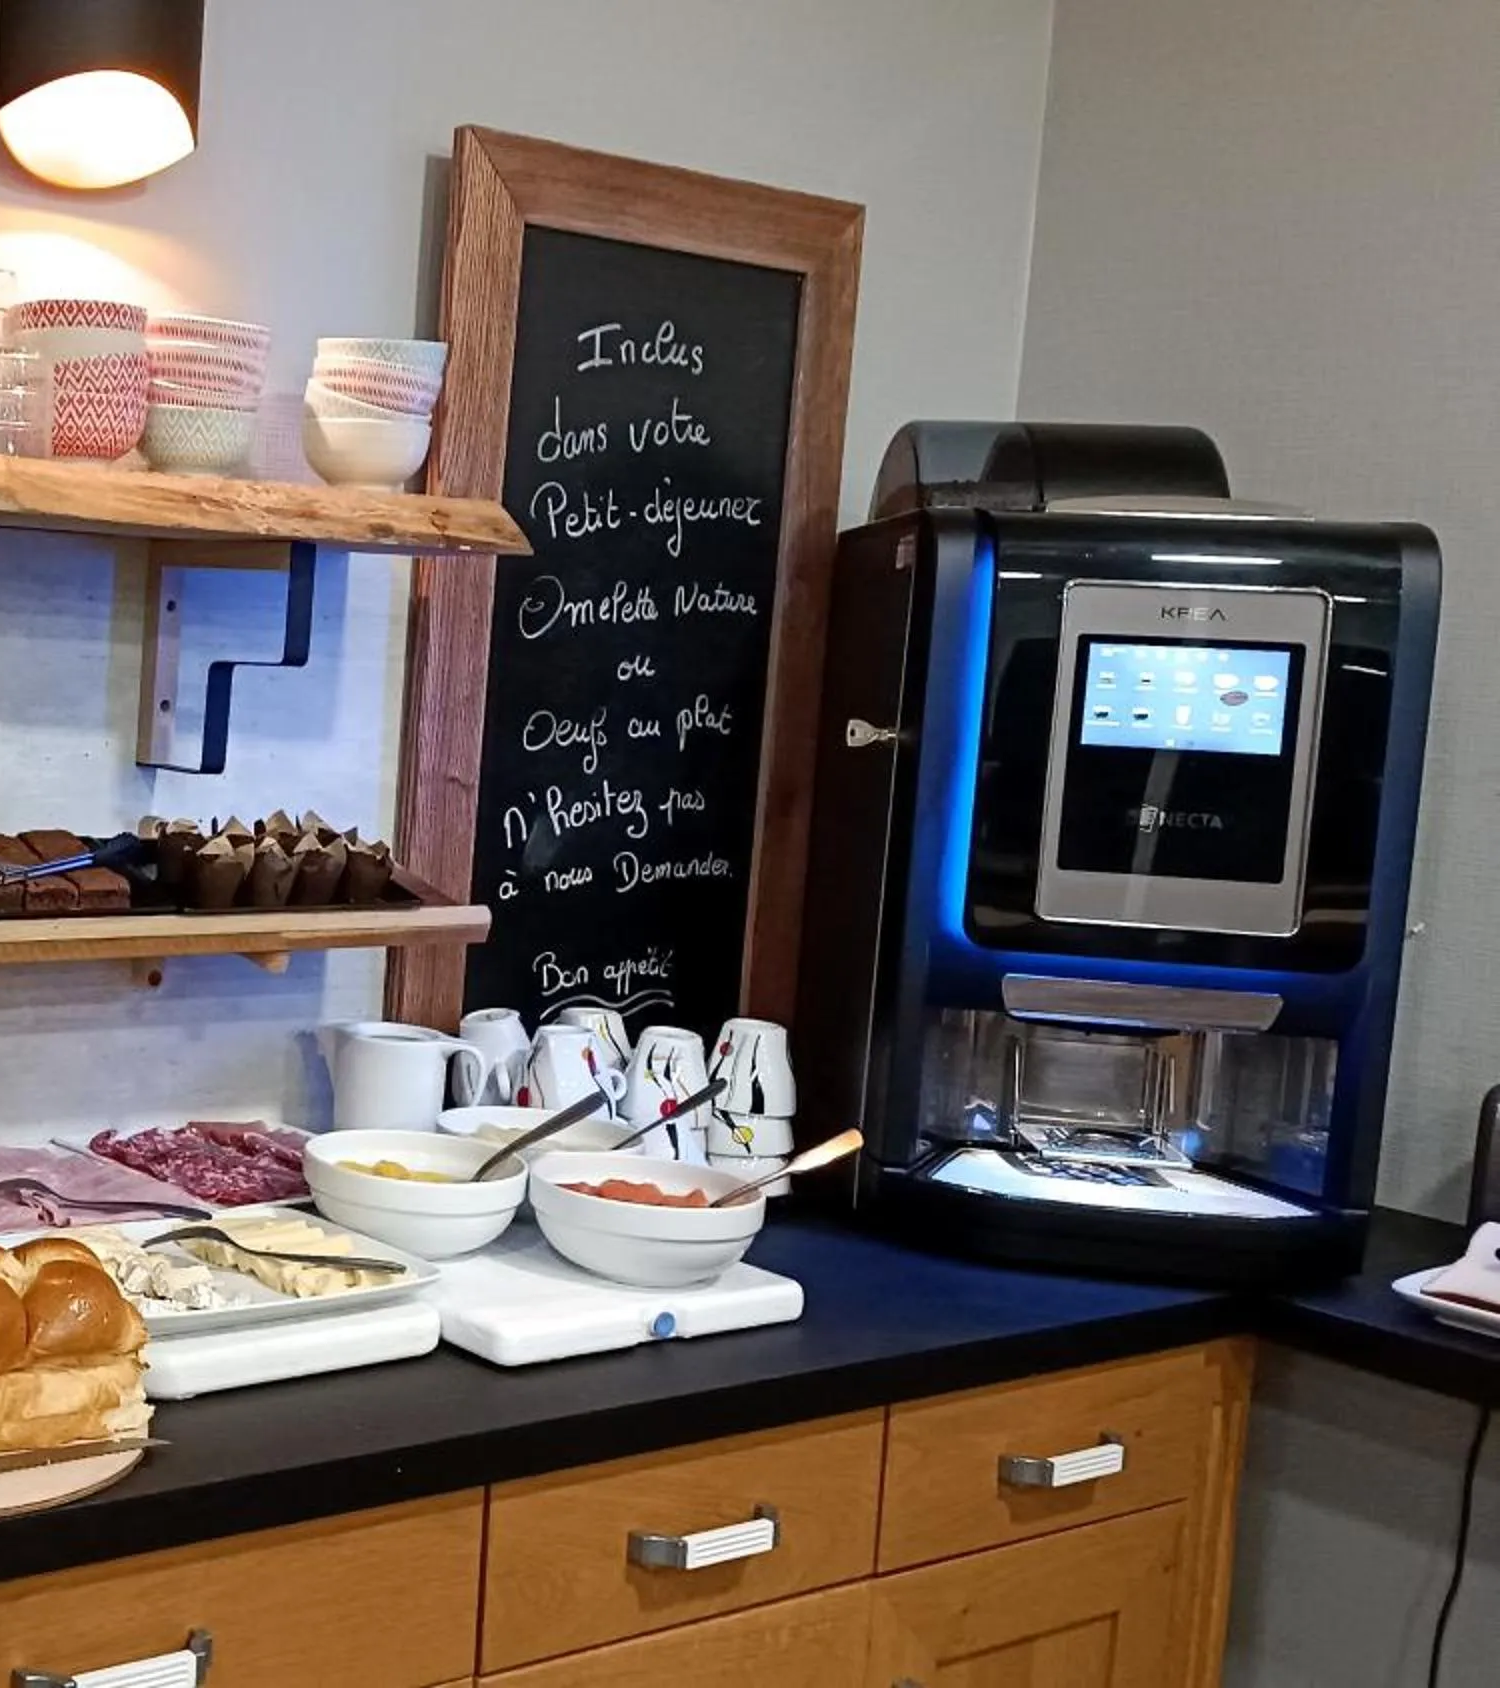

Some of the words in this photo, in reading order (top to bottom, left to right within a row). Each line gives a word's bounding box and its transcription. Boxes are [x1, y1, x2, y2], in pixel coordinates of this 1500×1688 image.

[577, 320, 703, 375] Inclus
[537, 396, 608, 462] dans
[629, 397, 711, 452] votre
[519, 575, 659, 639] Omelette
[616, 654, 656, 681] ou
[523, 705, 608, 774] Oeufs
[627, 715, 661, 738] au
[676, 694, 732, 752] plat
[658, 786, 706, 826] pas
[499, 868, 520, 900] à
[544, 865, 593, 893] nous
[532, 951, 589, 997] Bon
